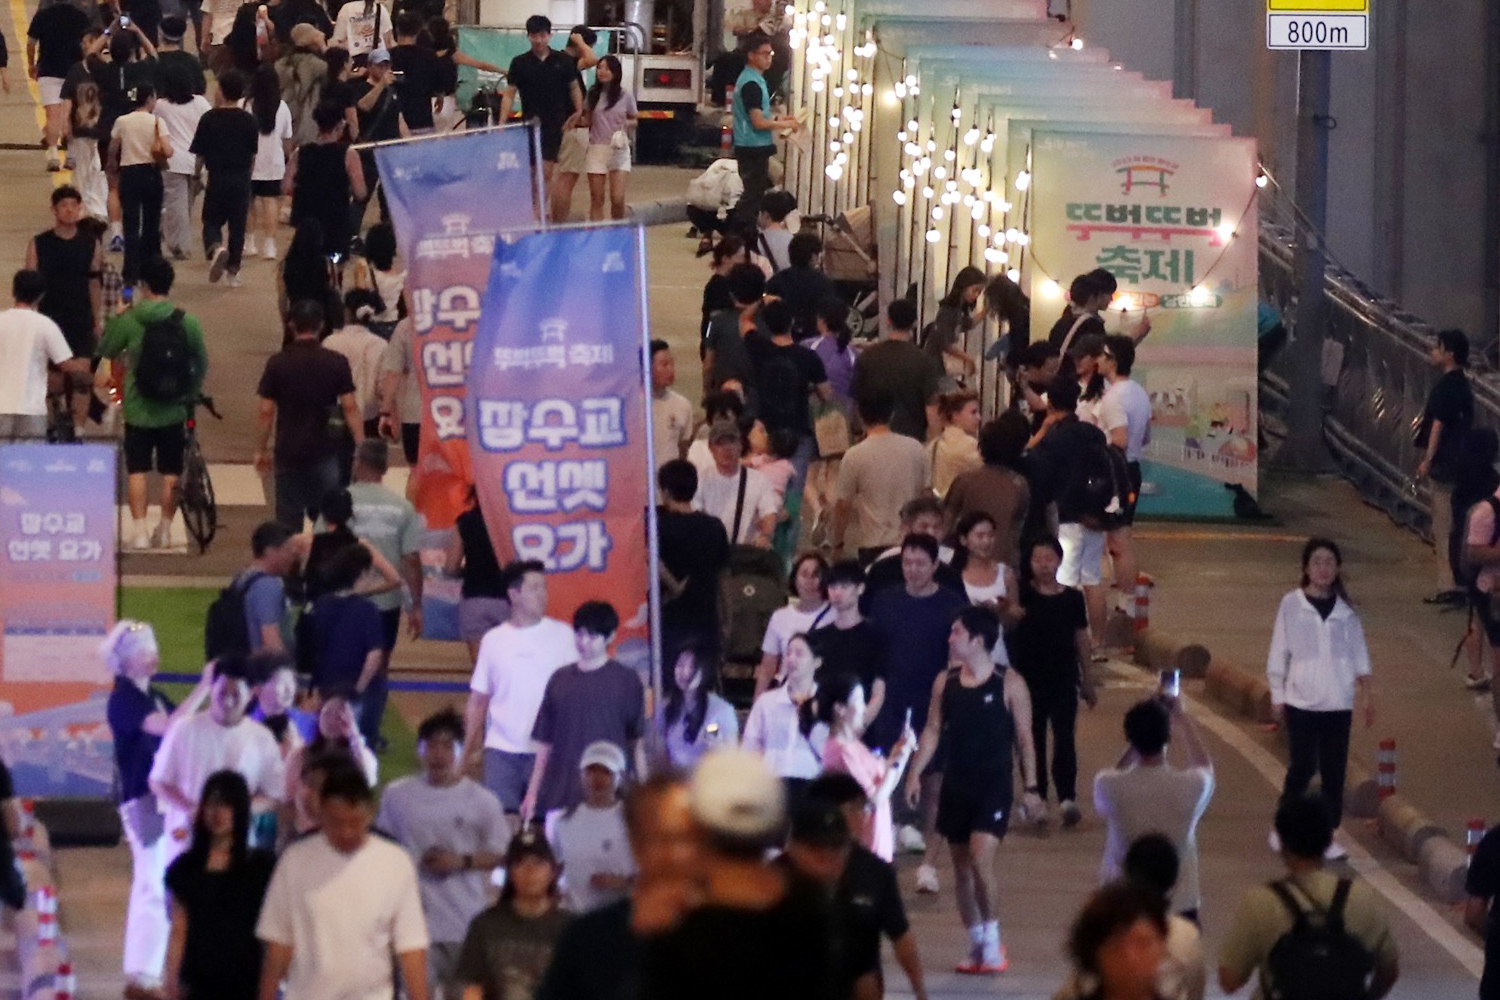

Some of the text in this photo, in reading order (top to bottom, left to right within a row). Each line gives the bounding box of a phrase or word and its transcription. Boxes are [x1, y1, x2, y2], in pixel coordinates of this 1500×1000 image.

[1287, 20, 1348, 44] 800m
[1065, 202, 1223, 247] 뚜벅뚜벅
[1095, 245, 1195, 284] 축제
[422, 341, 475, 388] 선
[430, 396, 466, 440] 요
[477, 396, 627, 450] 잠수교
[506, 459, 608, 512] 선셋
[58, 539, 103, 562] 요가
[512, 520, 612, 572] 요가
